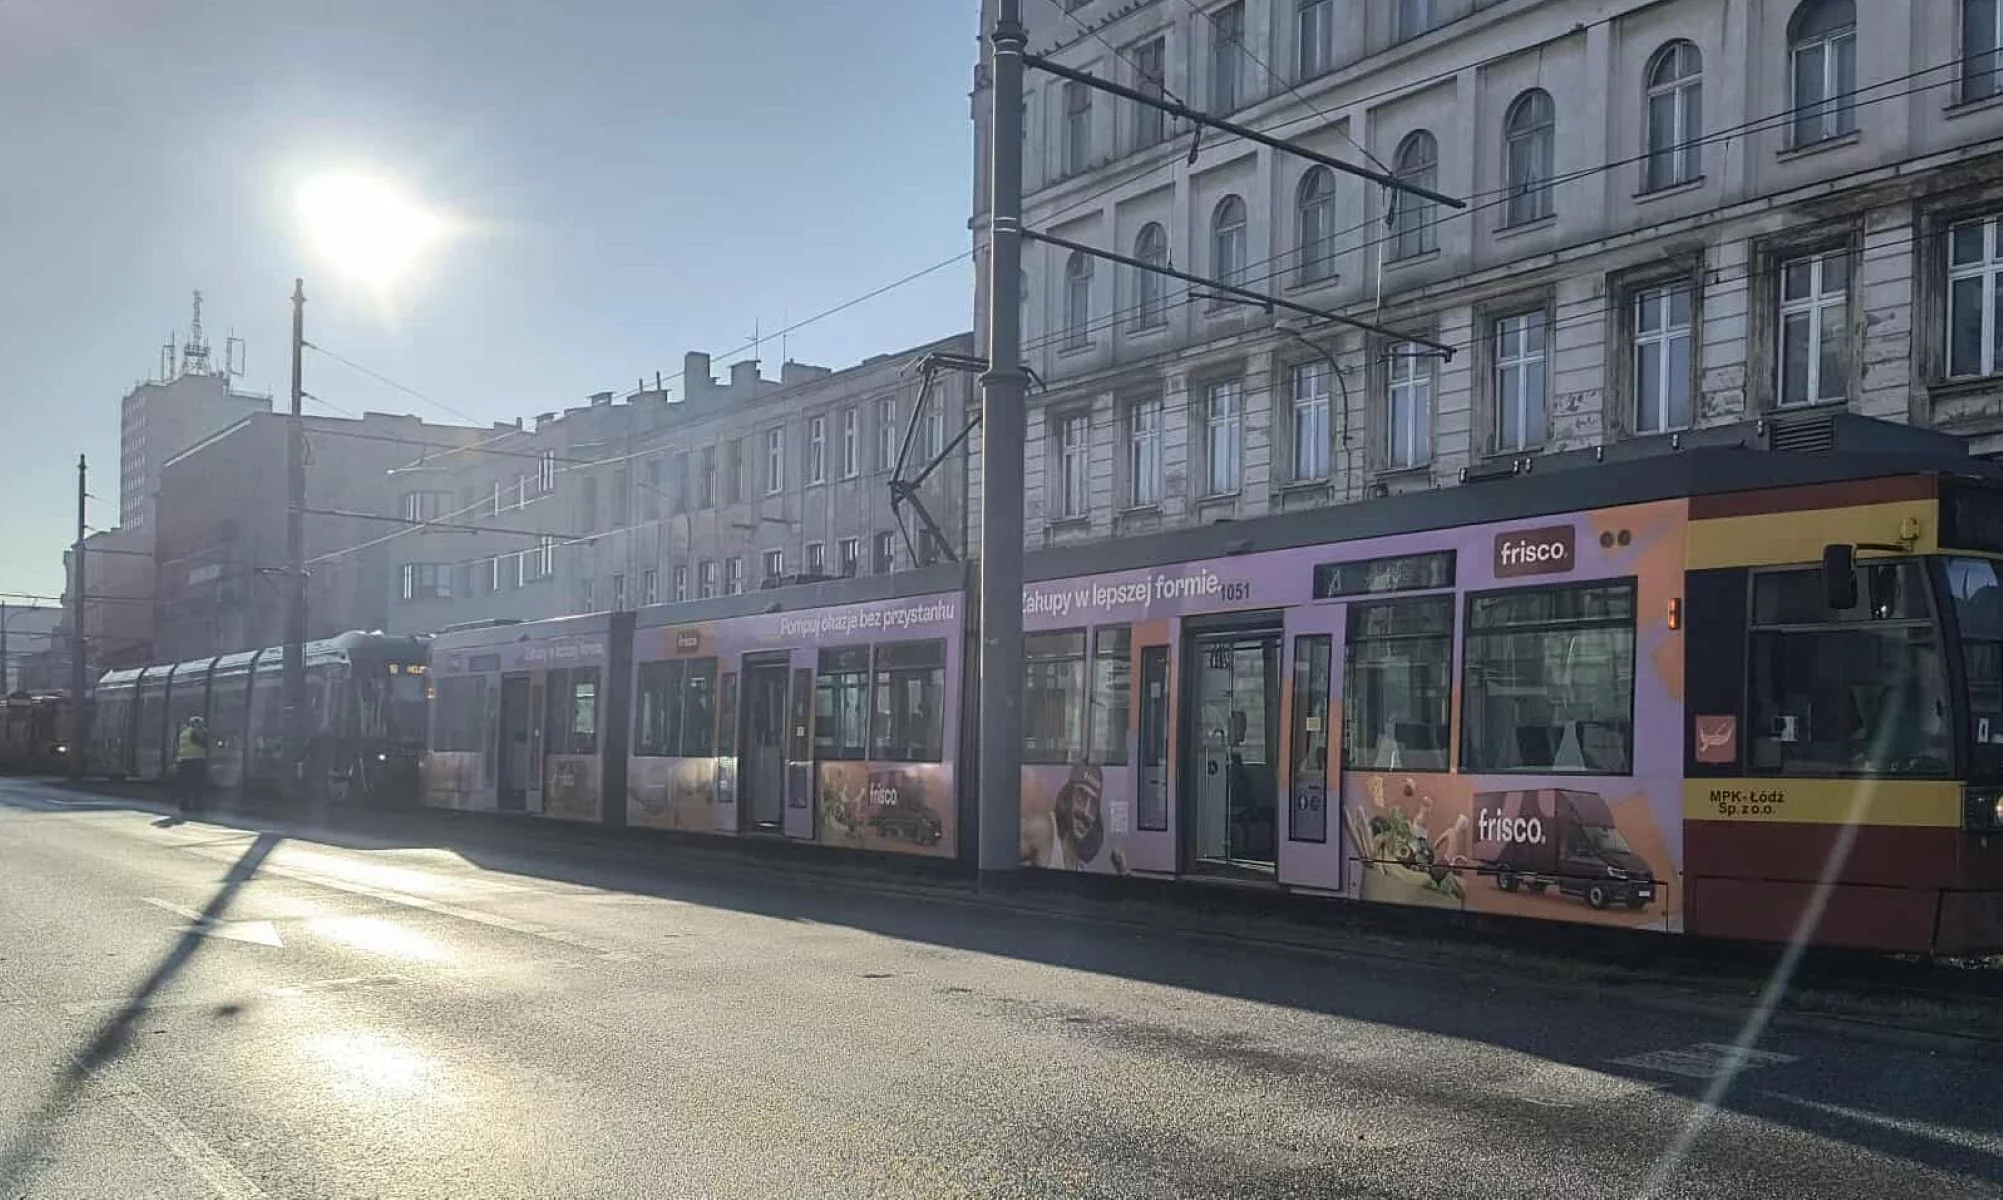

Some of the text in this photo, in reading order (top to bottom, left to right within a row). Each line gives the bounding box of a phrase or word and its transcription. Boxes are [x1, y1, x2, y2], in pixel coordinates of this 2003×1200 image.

[1501, 540, 1568, 565] frisco.
[1075, 589, 1090, 608] w
[1092, 575, 1153, 611] lepszej
[1156, 568, 1222, 599] formie.
[1221, 582, 1250, 600] 1051
[859, 608, 882, 629] bez
[883, 600, 955, 631] przystanku
[1719, 802, 1739, 816] Sp.
[1741, 805, 1749, 814] z
[1478, 808, 1546, 844] frisco.
